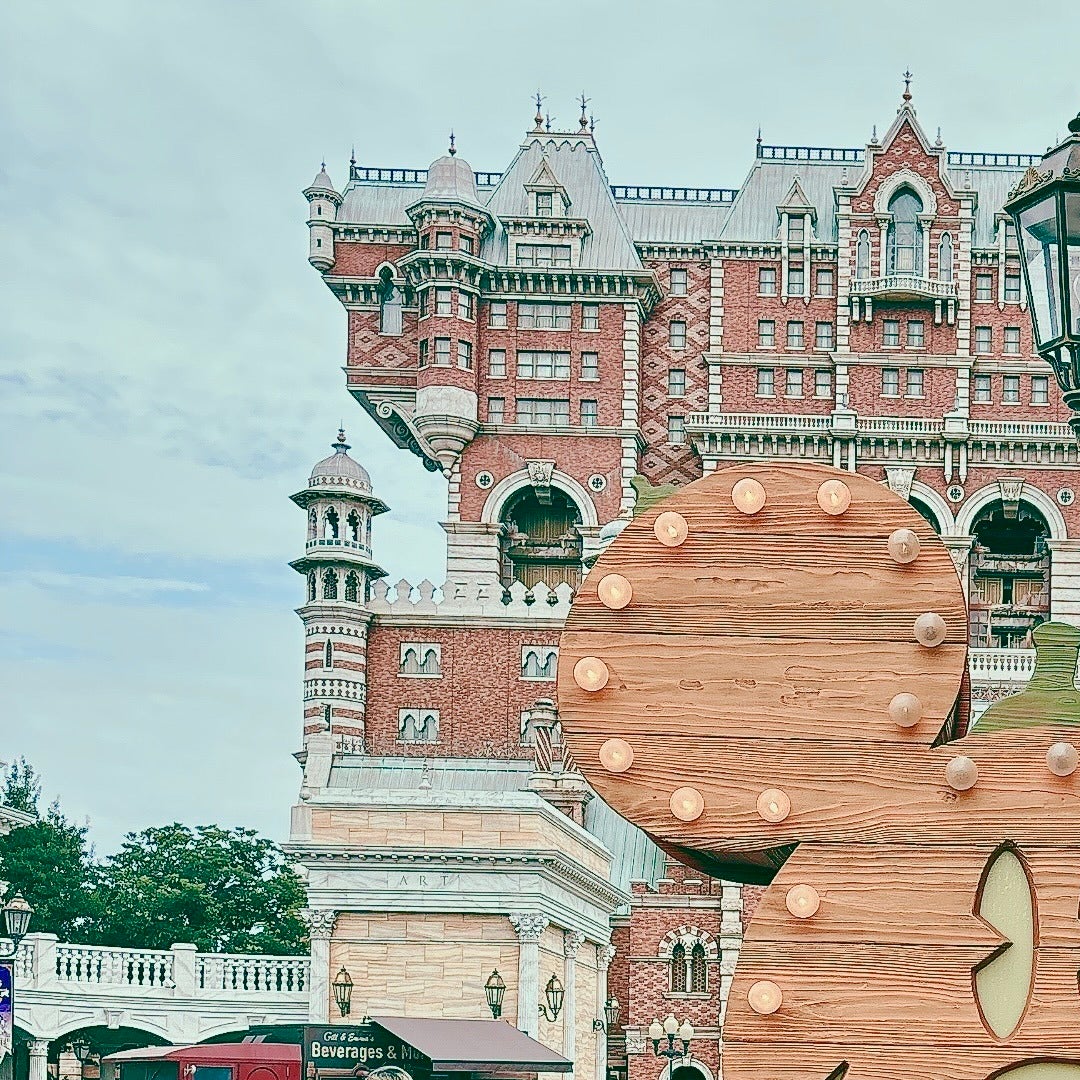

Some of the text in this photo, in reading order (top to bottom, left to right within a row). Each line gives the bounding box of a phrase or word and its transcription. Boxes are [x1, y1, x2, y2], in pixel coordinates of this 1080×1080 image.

[399, 874, 449, 886] ART
[311, 1041, 384, 1063] Beverages
[386, 1045, 398, 1060] &
